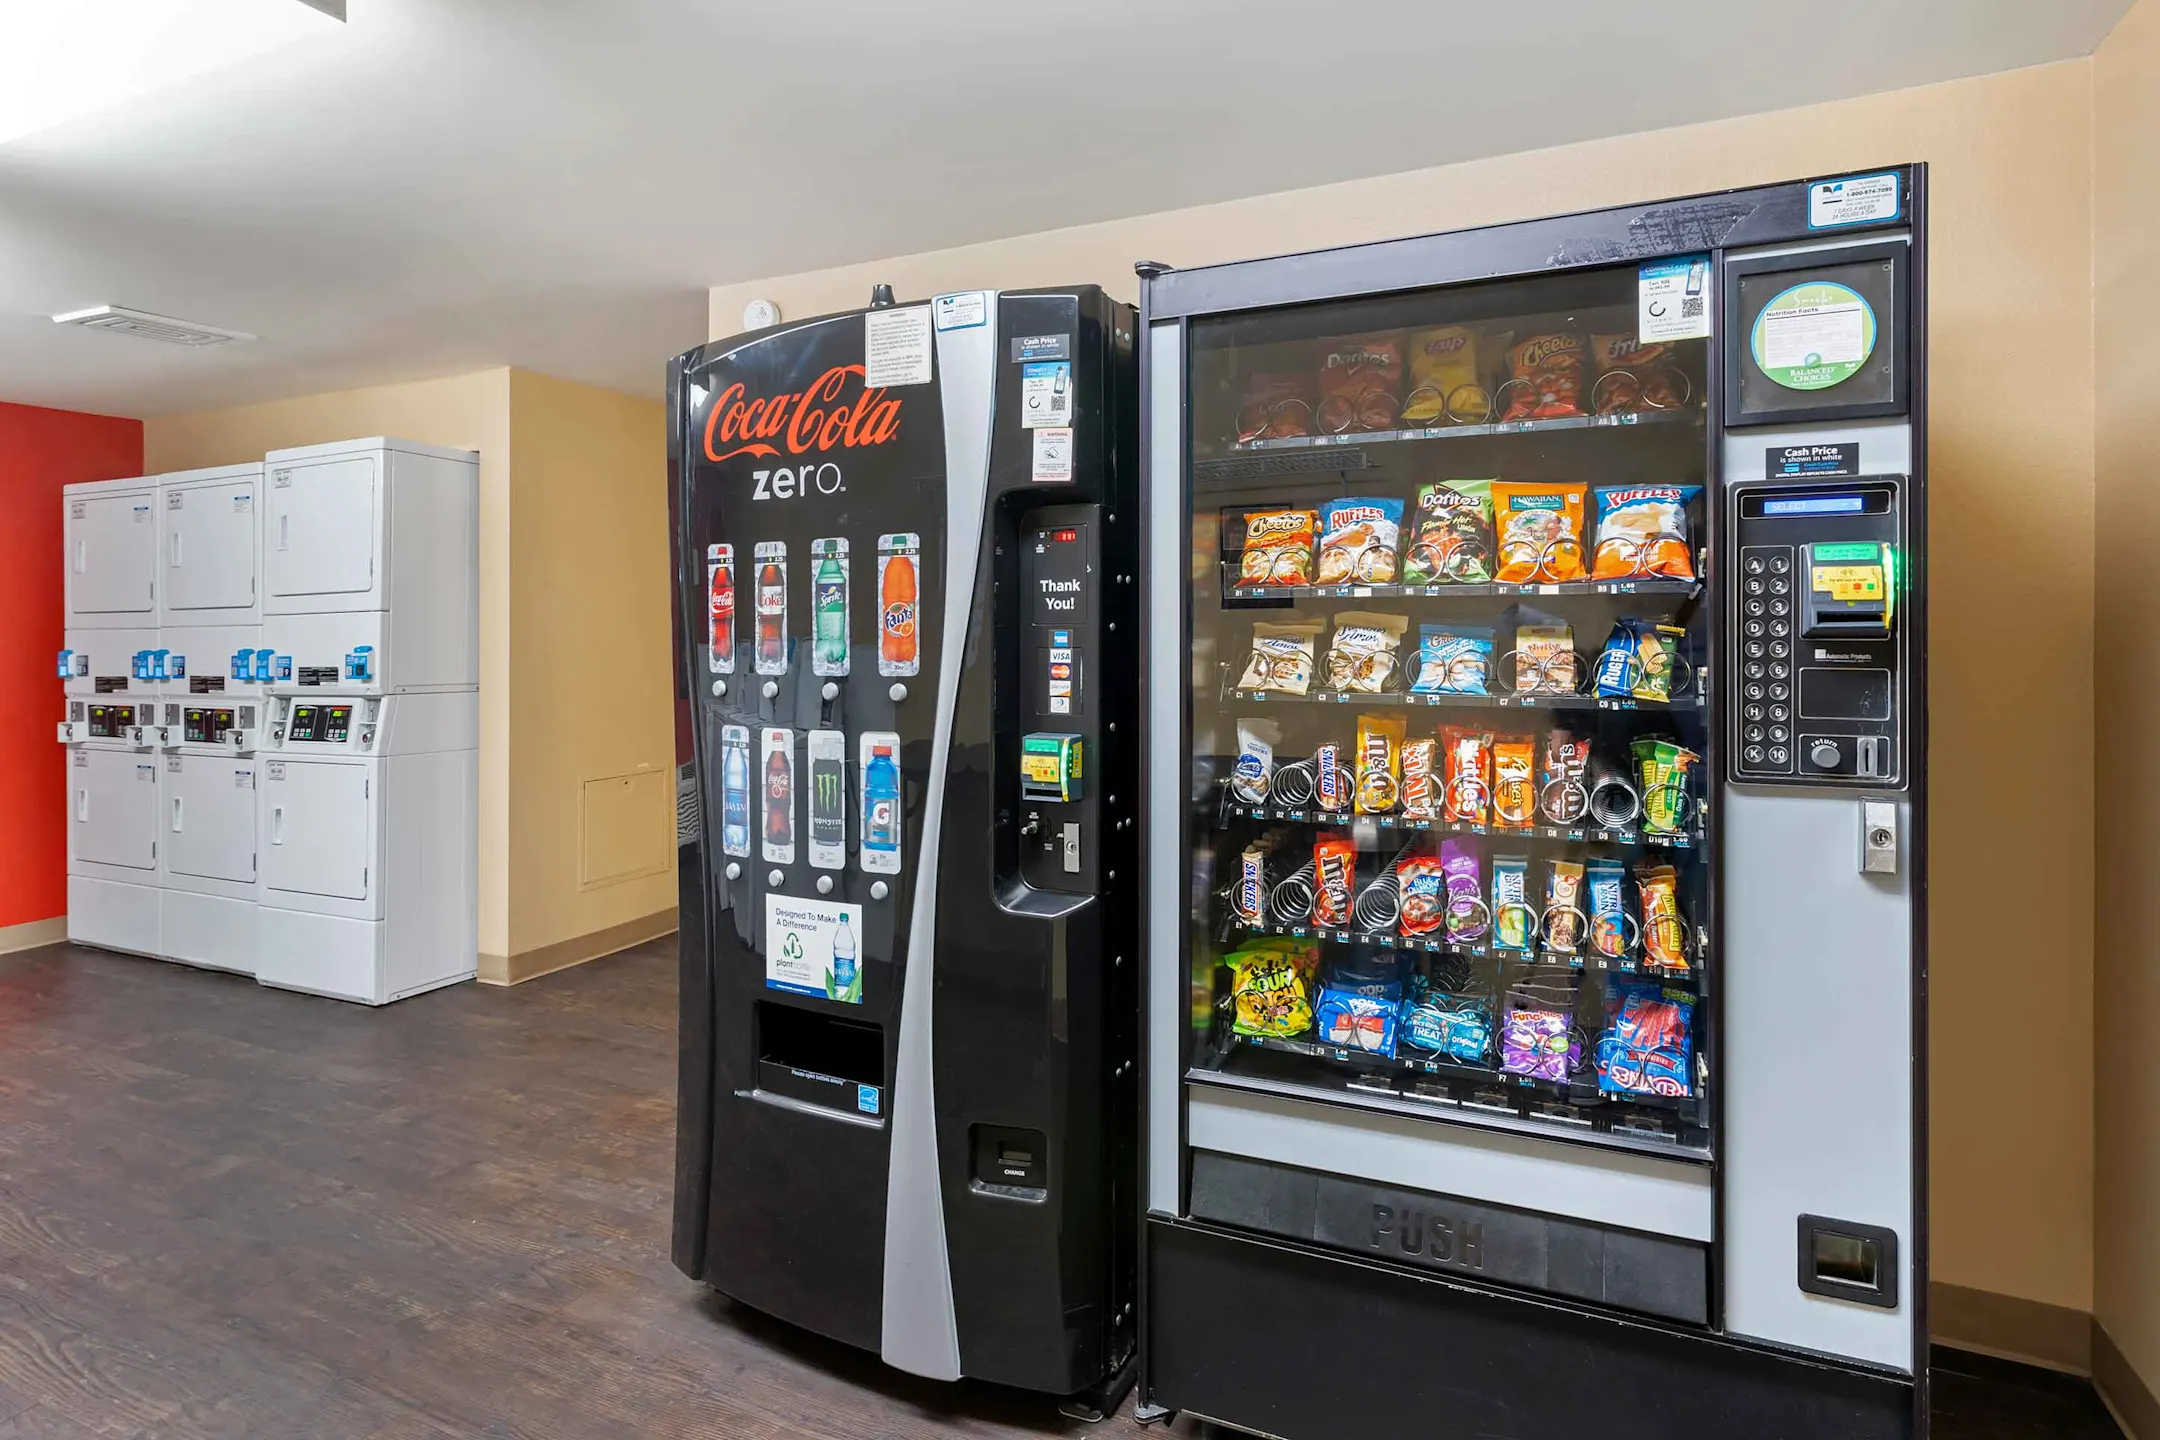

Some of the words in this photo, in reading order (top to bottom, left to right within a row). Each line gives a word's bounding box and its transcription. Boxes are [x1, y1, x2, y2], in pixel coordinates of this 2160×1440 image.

[1766, 309, 1797, 318] Nutrition
[1798, 306, 1819, 314] Facts
[1023, 338, 1039, 346] Cash
[1326, 353, 1391, 369] Doritos
[1789, 366, 1835, 377] BALANCED
[1793, 373, 1832, 383] CHOICES
[704, 364, 902, 462] Coca-Cola
[1784, 448, 1809, 457] Cash
[1811, 446, 1838, 455] Price
[1787, 455, 1811, 463] shown
[1821, 453, 1843, 461] white
[1423, 494, 1481, 509] Doritos
[1605, 488, 1682, 512] RUFFLES
[1331, 507, 1384, 529] RUFFLES
[1248, 515, 1305, 536] Cheetos
[1750, 560, 1759, 569] A
[1776, 560, 1782, 569] 1
[1039, 579, 1081, 592] Thank
[1597, 584, 1607, 593] B9
[1750, 581, 1759, 591] B
[1775, 581, 1783, 590] 2
[819, 591, 842, 608] Sprite
[1045, 597, 1075, 611] You!
[1750, 602, 1759, 612] C
[1775, 602, 1783, 611] 3
[1750, 623, 1759, 632] D
[1775, 623, 1783, 632] 4
[1751, 644, 1759, 653] E
[1775, 644, 1783, 654] 5
[1052, 652, 1070, 661] VISA
[284, 668, 290, 677] 9
[1600, 651, 1626, 686] RUGER
[1751, 665, 1759, 674] F
[1775, 665, 1782, 675] 6
[1235, 691, 1243, 699] C1
[1750, 686, 1759, 695] G
[1775, 687, 1783, 696] 7
[1406, 696, 1415, 704] C5
[1500, 698, 1509, 706] C7
[1599, 700, 1609, 708] C9
[1750, 707, 1759, 716] H
[1774, 708, 1782, 717] 8
[1750, 728, 1758, 737] J
[1774, 729, 1782, 738] 9
[1810, 738, 1838, 748] return
[1750, 749, 1759, 758] K
[1772, 750, 1785, 759] 10
[1322, 748, 1335, 796] SNICKERS
[1403, 747, 1429, 805] TWIX
[1460, 739, 1479, 812] Skittles
[872, 802, 890, 825] G
[1452, 823, 1461, 831] D6
[1547, 829, 1557, 837] D8
[1598, 832, 1609, 840] D9
[1648, 836, 1663, 844] D10
[1413, 876, 1431, 887] BLUE
[1244, 863, 1256, 911] SNICKERS
[775, 907, 806, 920] Designed
[807, 912, 816, 921] To
[817, 914, 837, 924] Make
[776, 918, 782, 926] A
[782, 919, 818, 932] Difference
[1276, 926, 1284, 934] E2
[1598, 960, 1608, 968] E9
[1247, 970, 1293, 992] SOUR
[1318, 1021, 1324, 1030] 2
[1413, 1025, 1448, 1043] TREAT
[1451, 1035, 1478, 1050] Original
[1317, 1047, 1325, 1055] F3
[1499, 1074, 1507, 1082] F7
[1655, 1078, 1688, 1097] RED
[1370, 1203, 1485, 1270] PUSH
